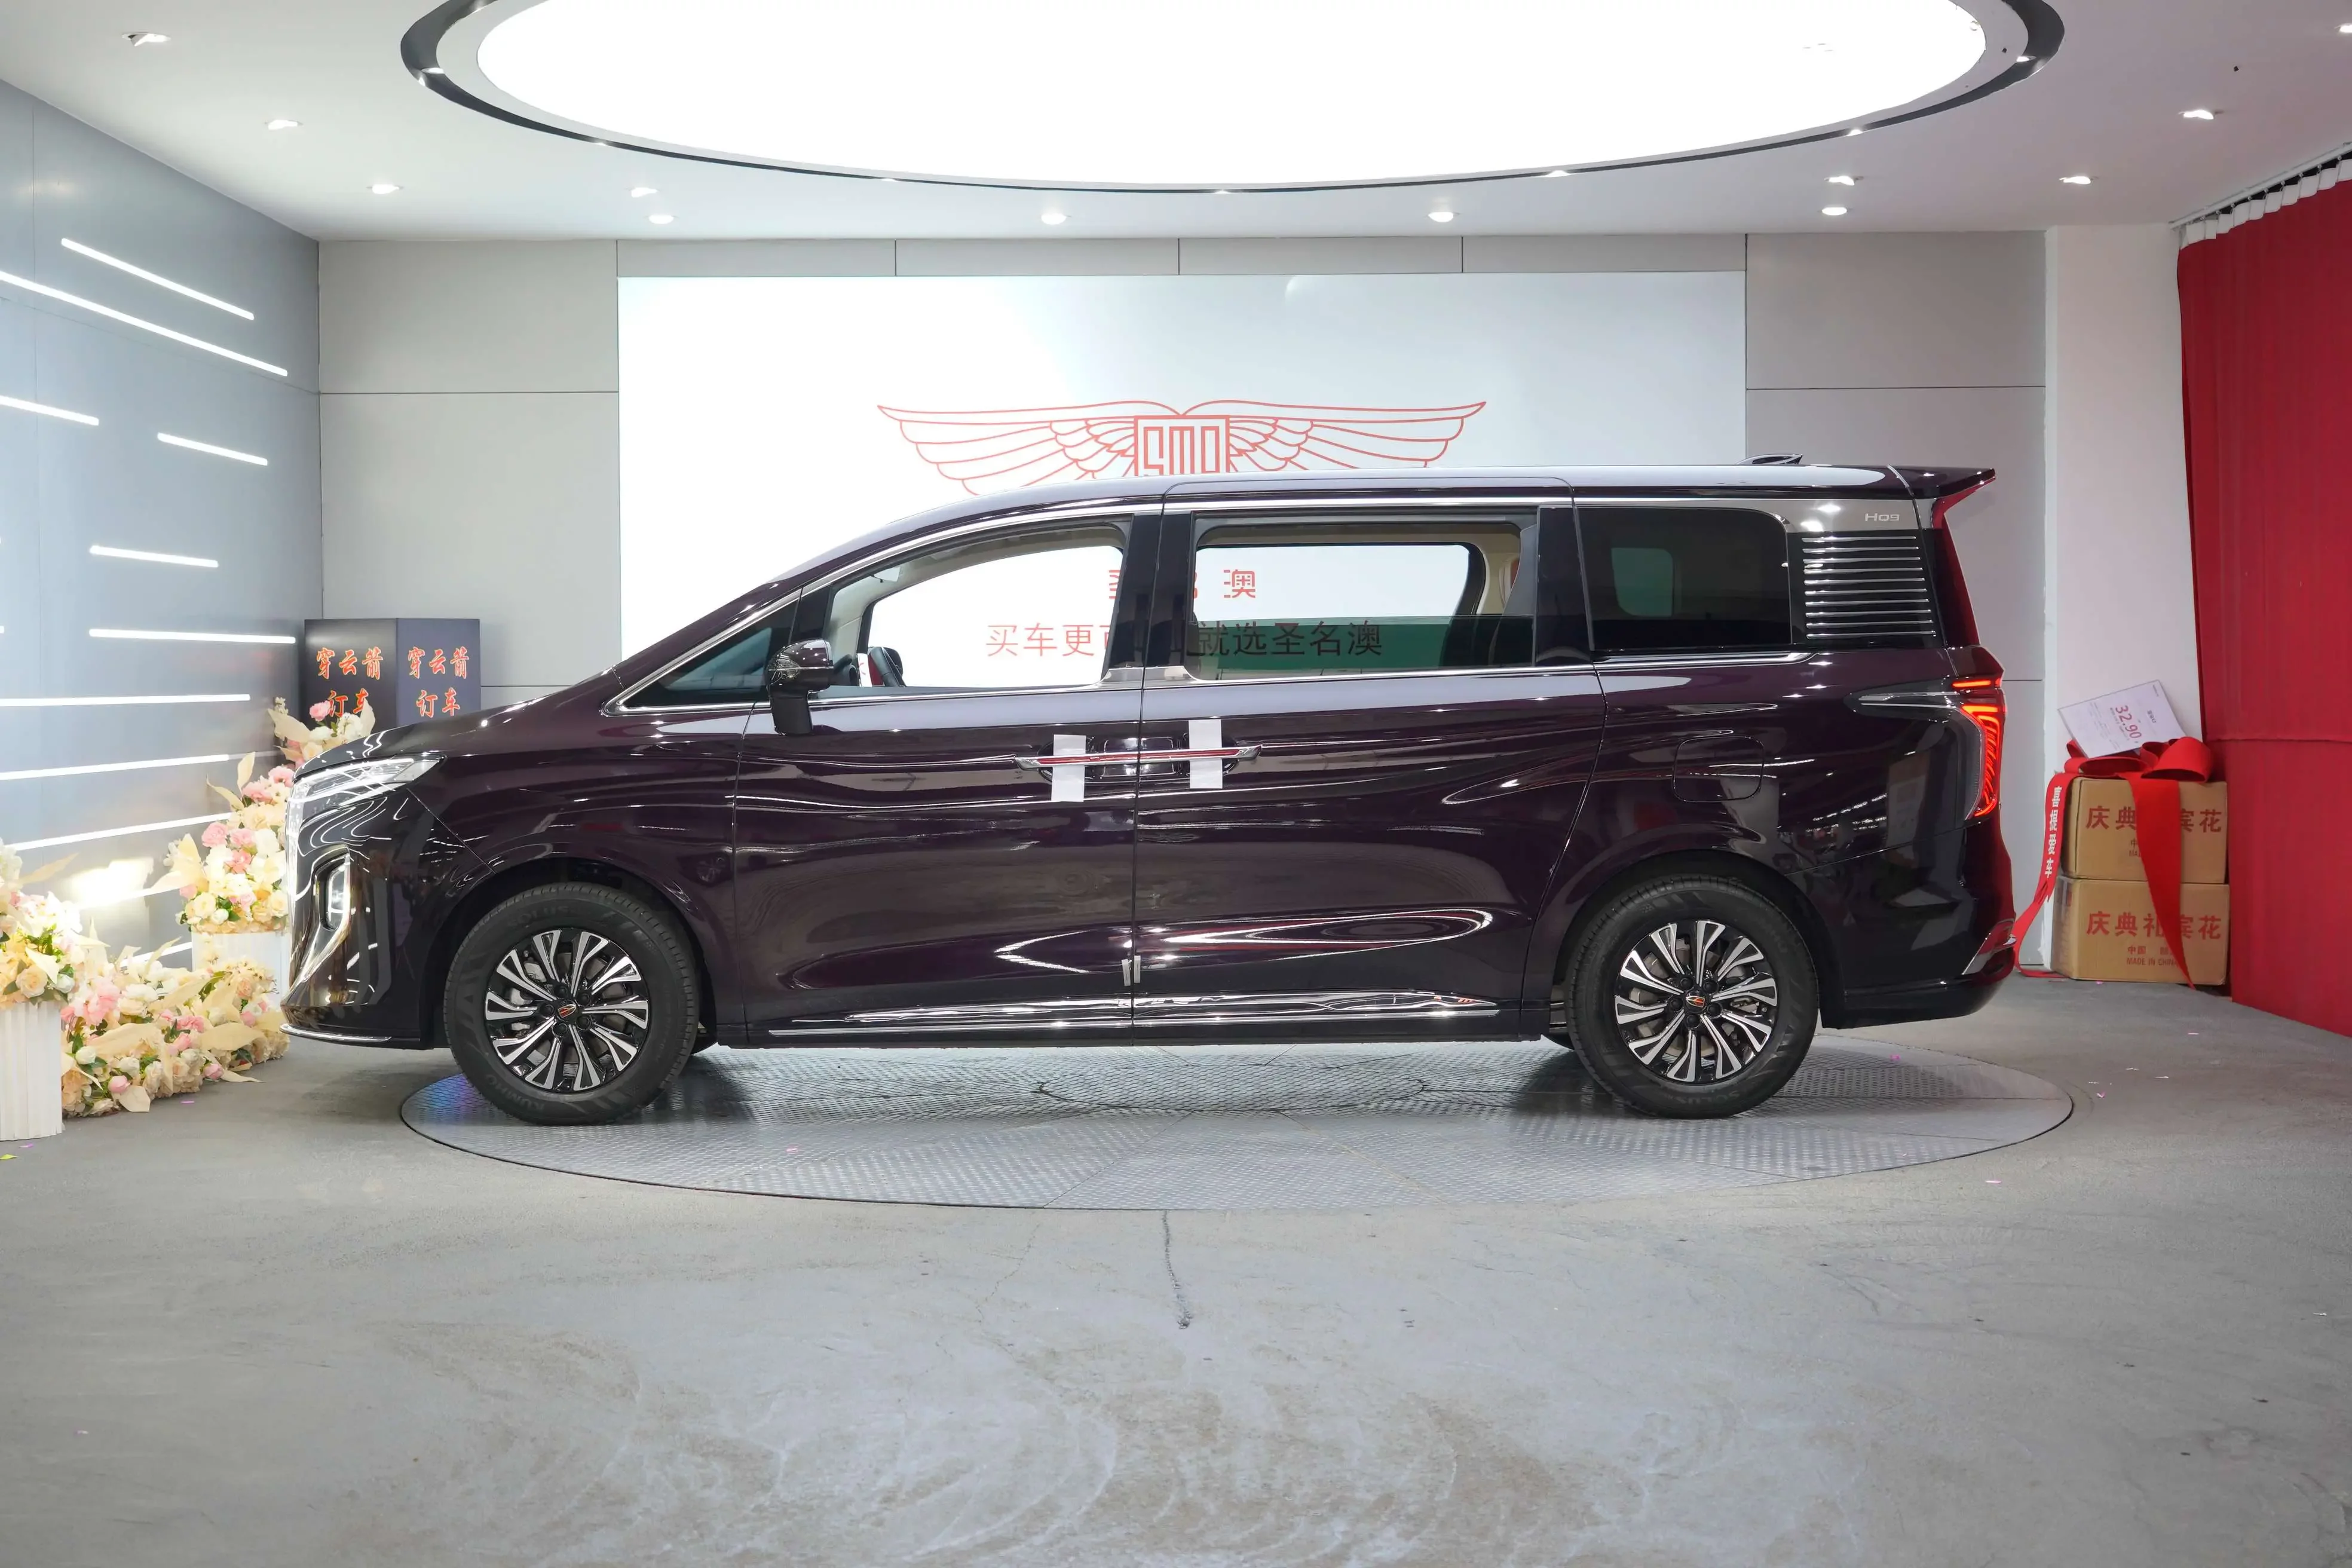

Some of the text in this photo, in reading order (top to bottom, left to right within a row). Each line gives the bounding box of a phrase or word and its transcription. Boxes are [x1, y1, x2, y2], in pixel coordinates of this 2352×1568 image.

[1865, 513, 1900, 522] HQ9
[1196, 620, 1382, 657] 就选圣名澳
[317, 646, 383, 680] 穿云箭
[408, 646, 469, 679] 穿云箭
[416, 687, 460, 718] 订车
[2115, 705, 2142, 739] 32.90
[2086, 806, 2222, 832] 庆典宾花
